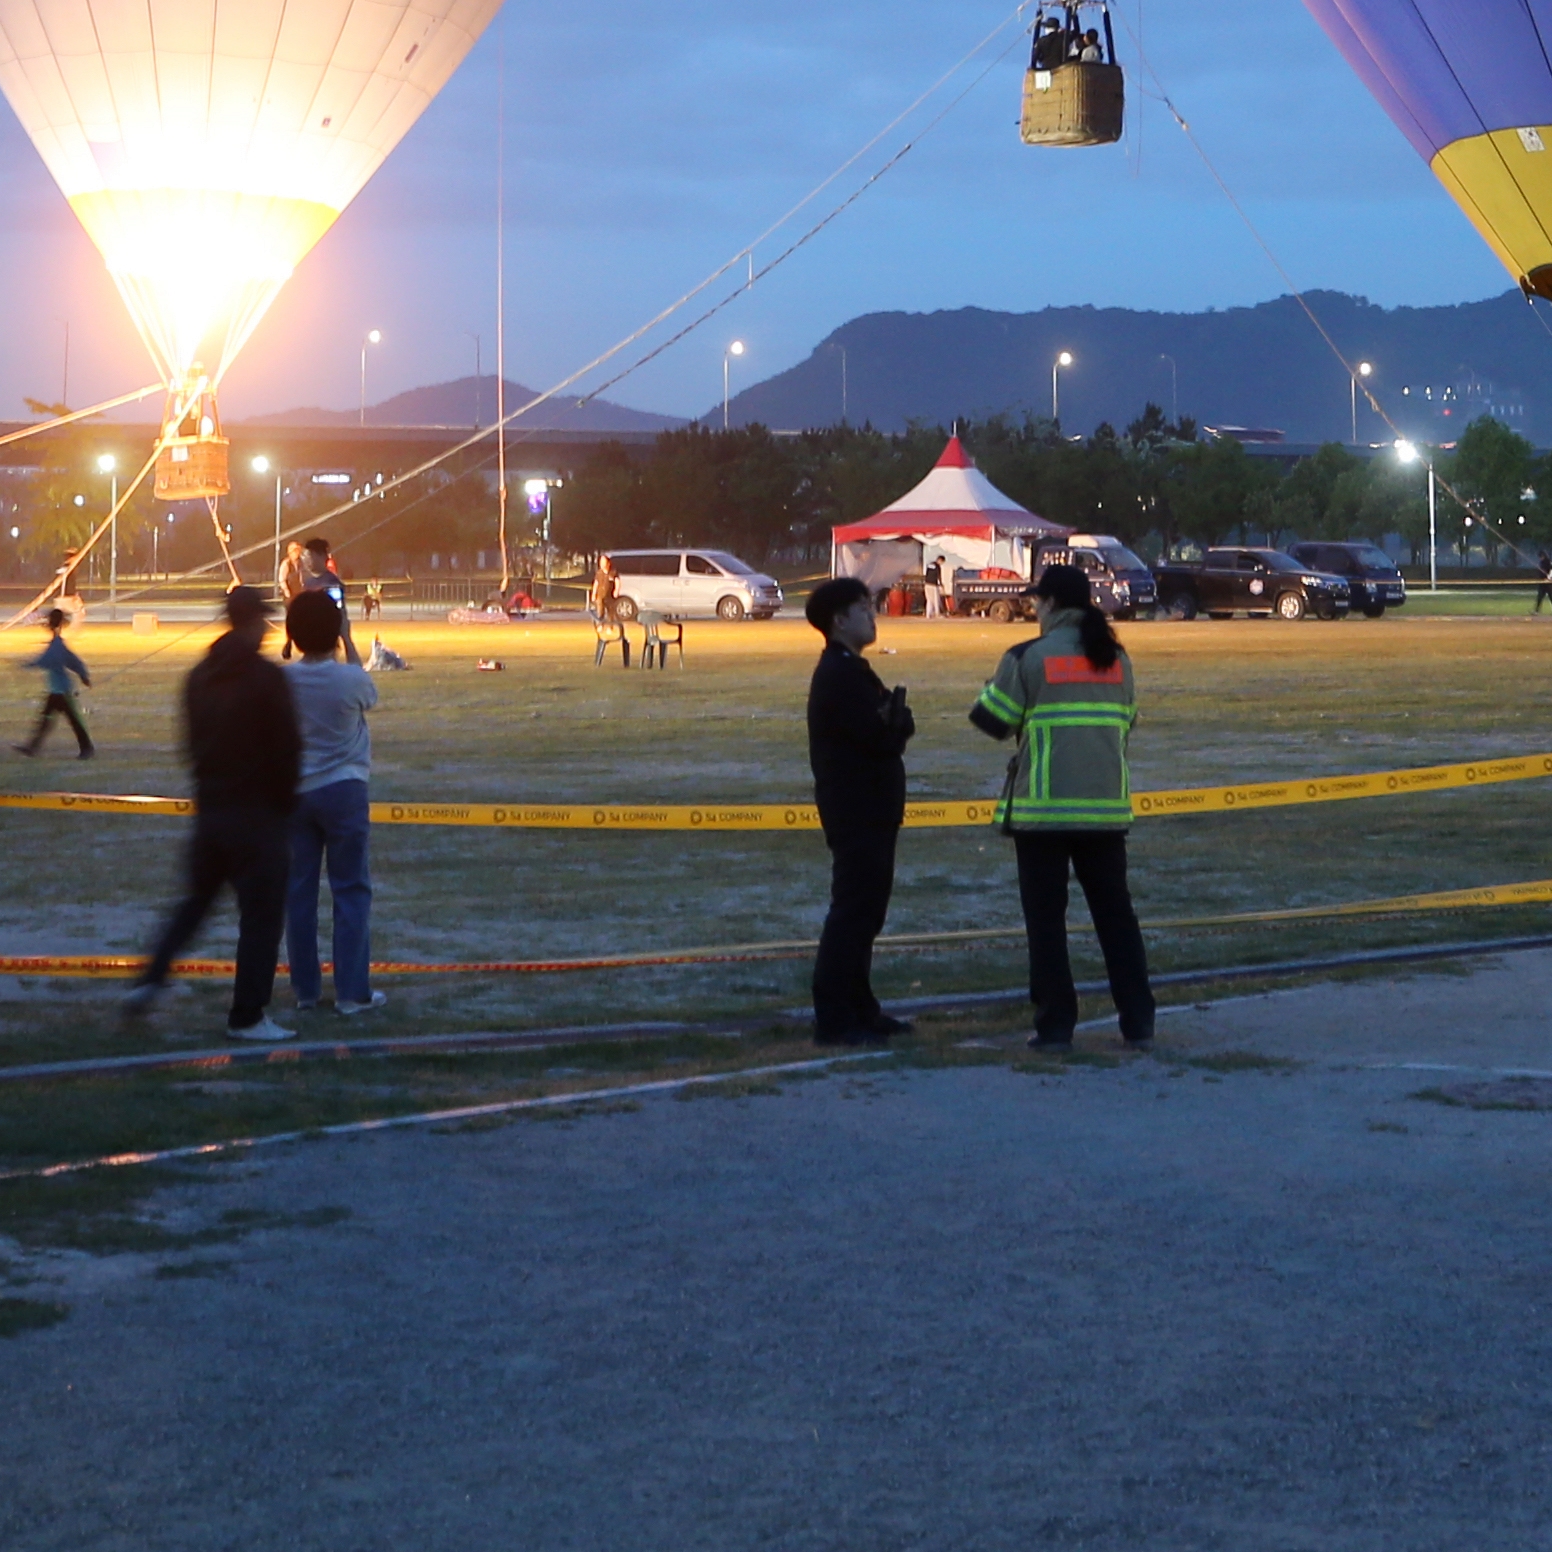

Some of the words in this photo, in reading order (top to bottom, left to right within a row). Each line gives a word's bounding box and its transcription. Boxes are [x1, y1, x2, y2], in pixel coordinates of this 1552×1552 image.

[1166, 795, 1206, 806] COMPANY
[524, 812, 571, 822] COMPANY
[623, 813, 668, 823] COMPANY
[720, 813, 762, 822] COMPANY
[904, 809, 946, 818] COMPANY
